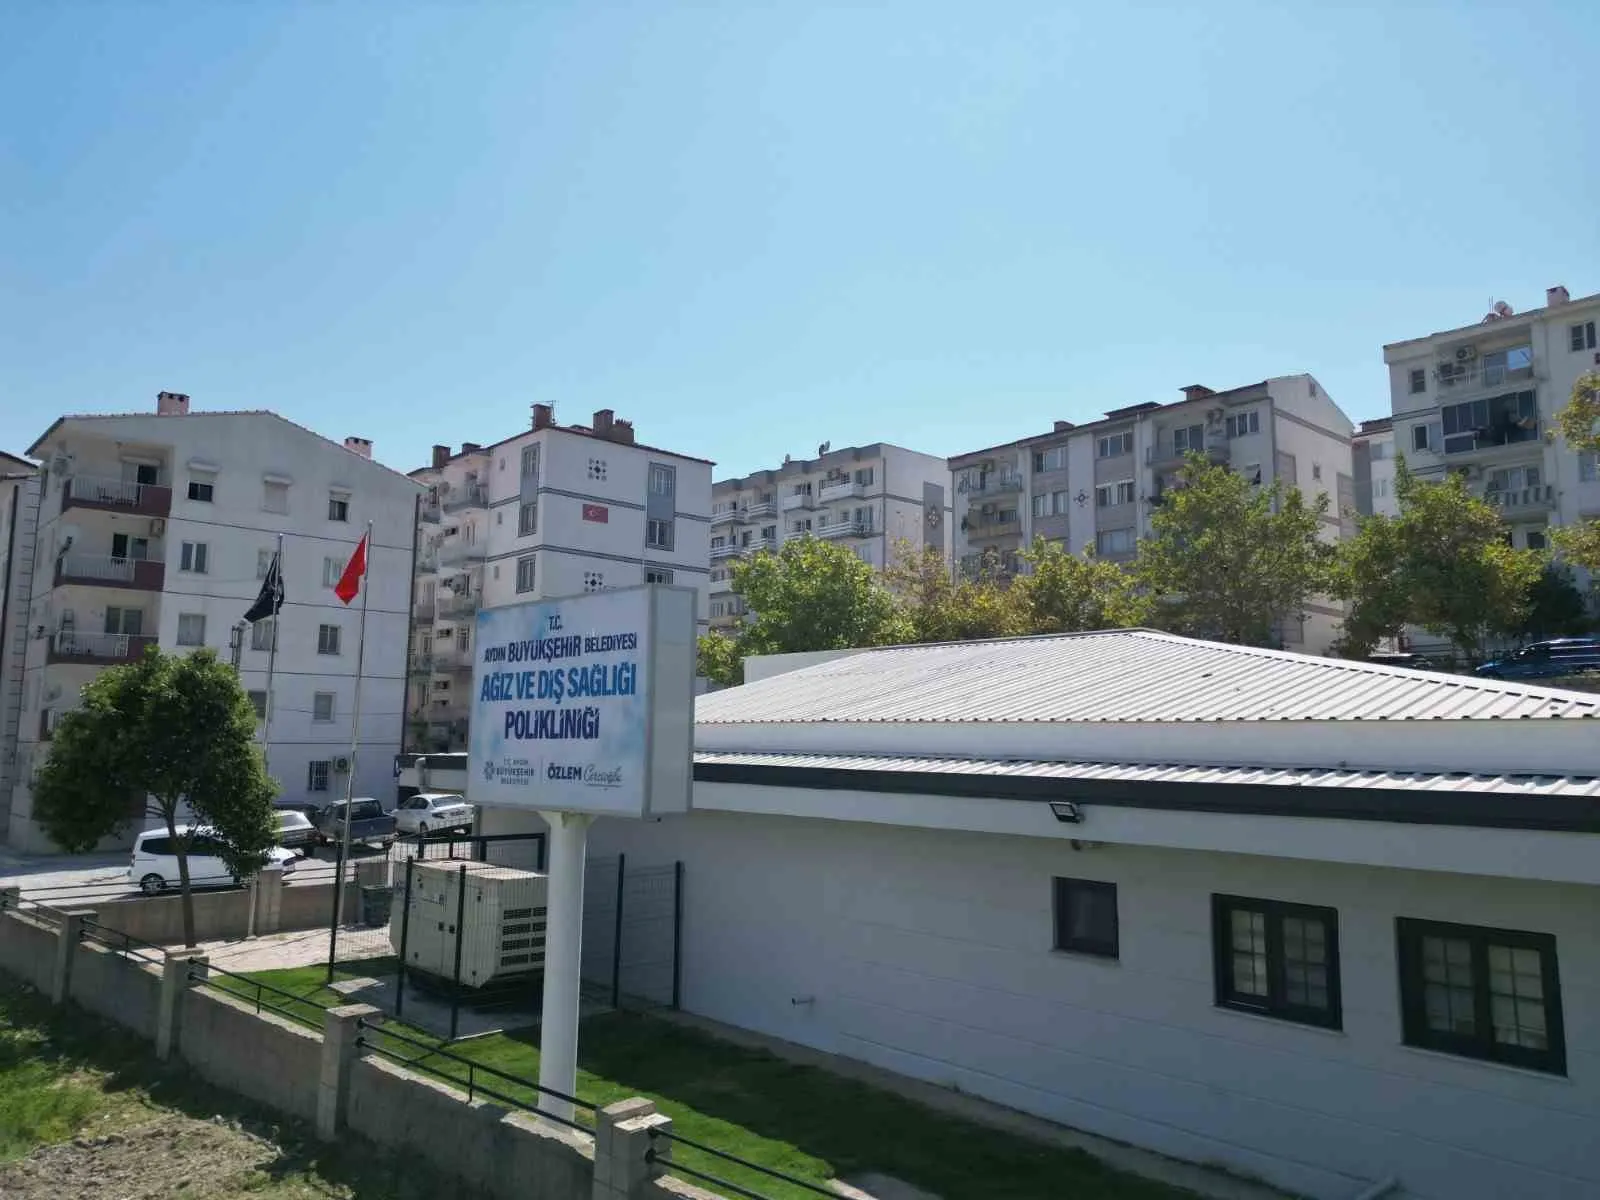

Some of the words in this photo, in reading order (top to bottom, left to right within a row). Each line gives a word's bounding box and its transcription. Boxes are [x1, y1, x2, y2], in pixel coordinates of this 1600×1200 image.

[548, 614, 563, 631] T.C.
[483, 647, 506, 662] AYDIN
[508, 635, 581, 663] BÜYÜKŞEHİR
[584, 632, 638, 653] BELEDİYESİ
[480, 671, 514, 701] AĞIZ
[515, 671, 535, 700] VE
[537, 668, 565, 704] DİŞ
[567, 661, 637, 697] SAĞLIĞI
[504, 705, 600, 740] POLİKLİNİĞİ
[547, 762, 582, 780] ÖZLEM
